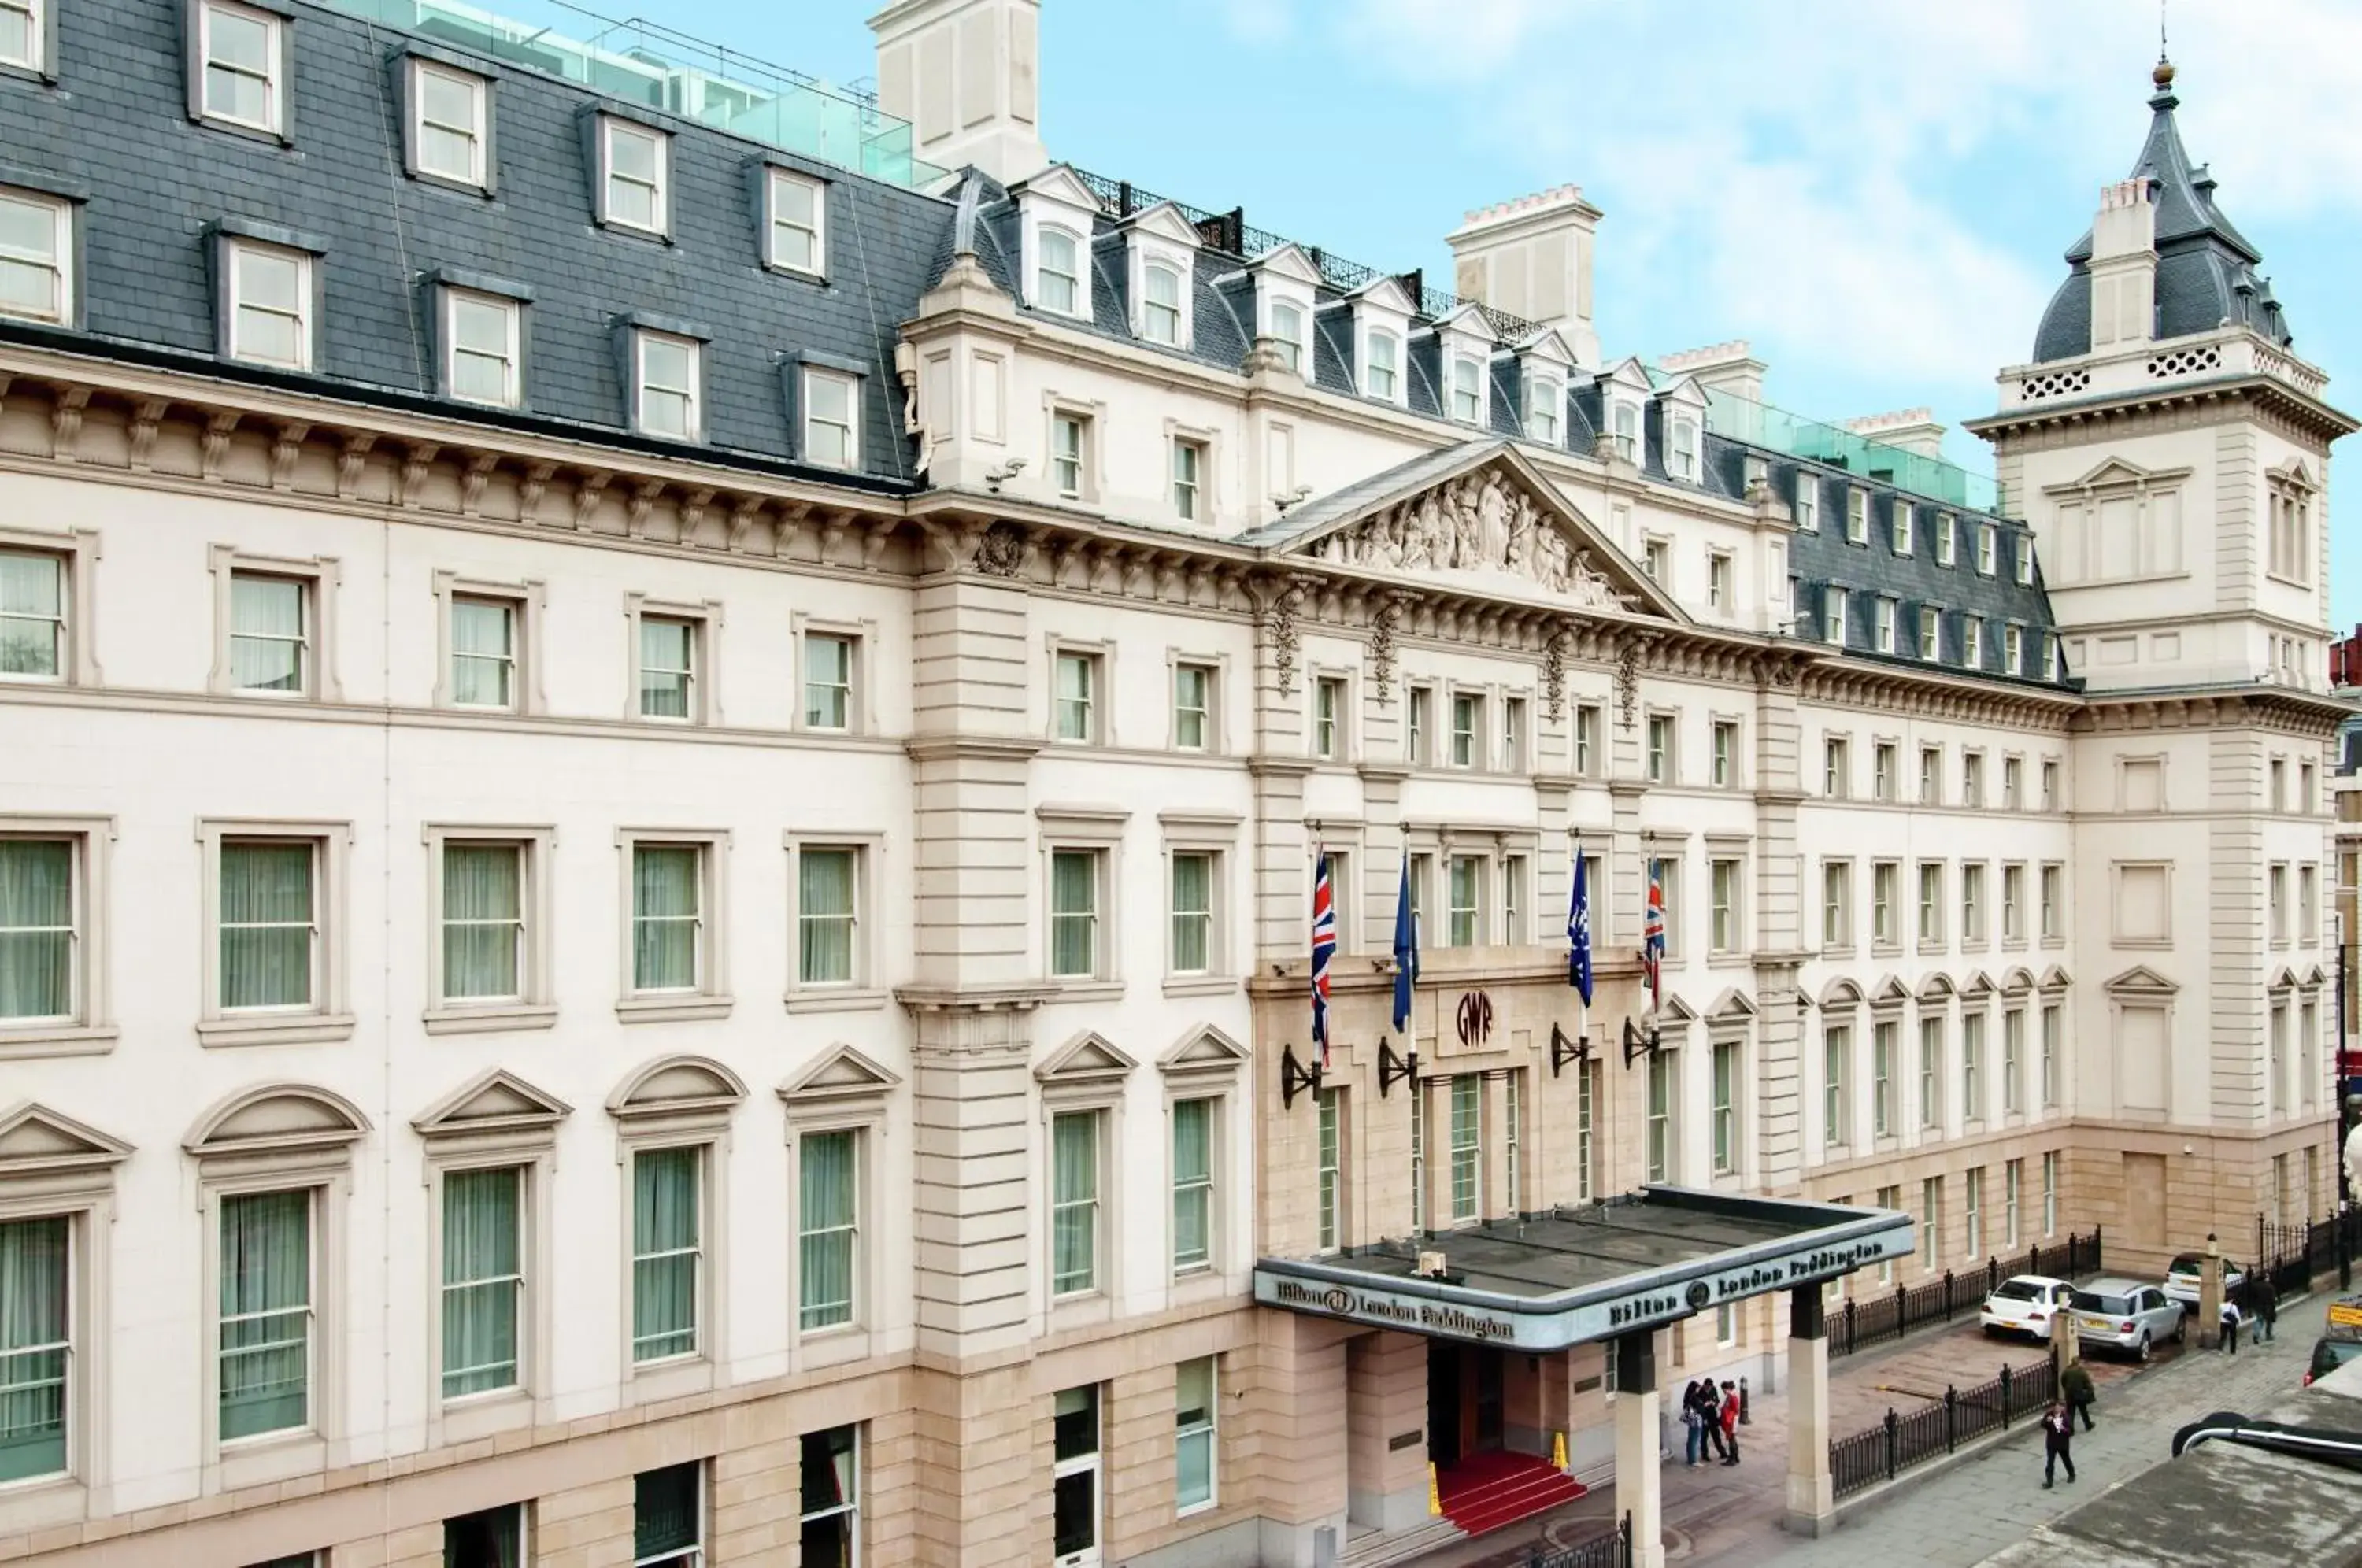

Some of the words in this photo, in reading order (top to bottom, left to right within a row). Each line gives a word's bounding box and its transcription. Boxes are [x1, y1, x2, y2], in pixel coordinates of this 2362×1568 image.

[1457, 991, 1494, 1048] GWR
[1277, 1281, 1323, 1305] Hilton
[1360, 1295, 1416, 1322] London
[1420, 1304, 1514, 1338] Paddington
[1610, 1296, 1677, 1326] Hilton
[1718, 1269, 1783, 1296] London
[1790, 1244, 1883, 1277] Paddington
